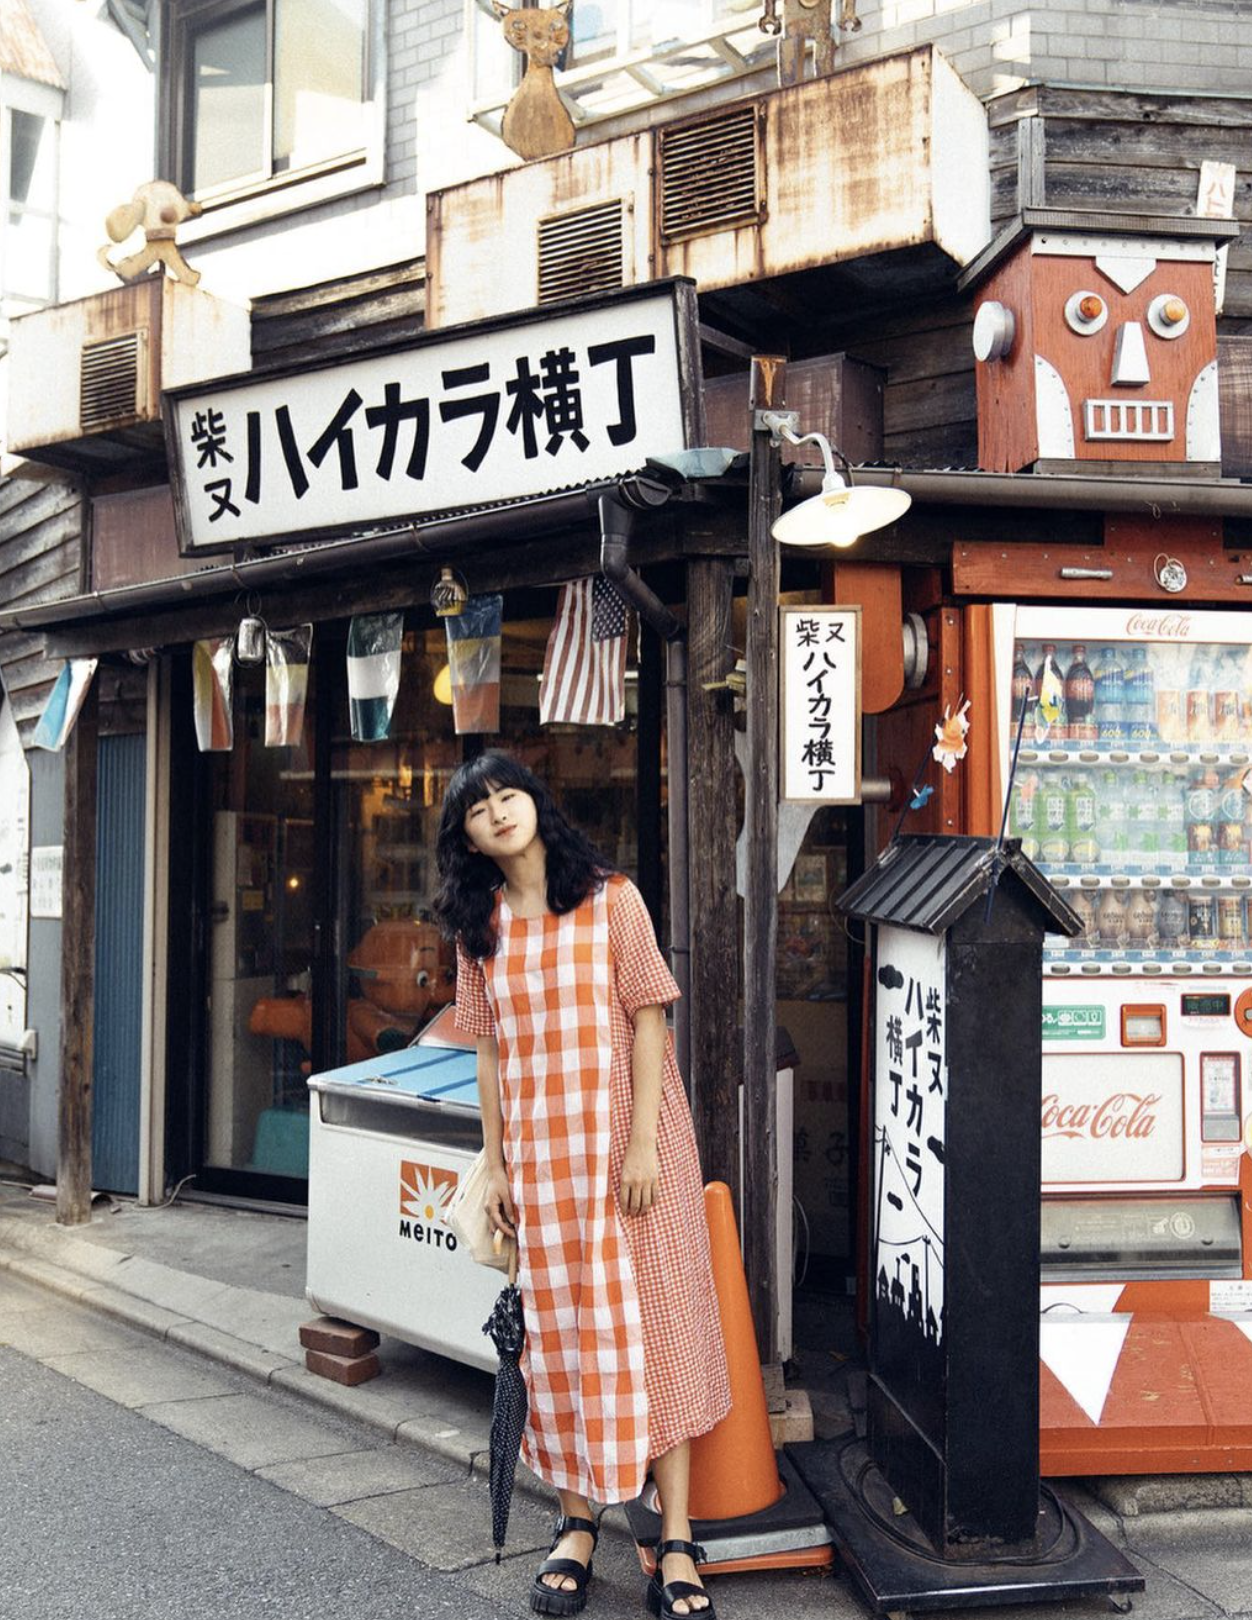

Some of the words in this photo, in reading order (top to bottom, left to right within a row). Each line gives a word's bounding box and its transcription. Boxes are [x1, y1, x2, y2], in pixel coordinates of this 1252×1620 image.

[190, 408, 241, 523] 柴又
[244, 334, 656, 504] ハイカラ横丁
[795, 619, 845, 647] 柴又
[801, 651, 837, 792] ハイカラ横丁
[926, 987, 944, 1096] 柴又
